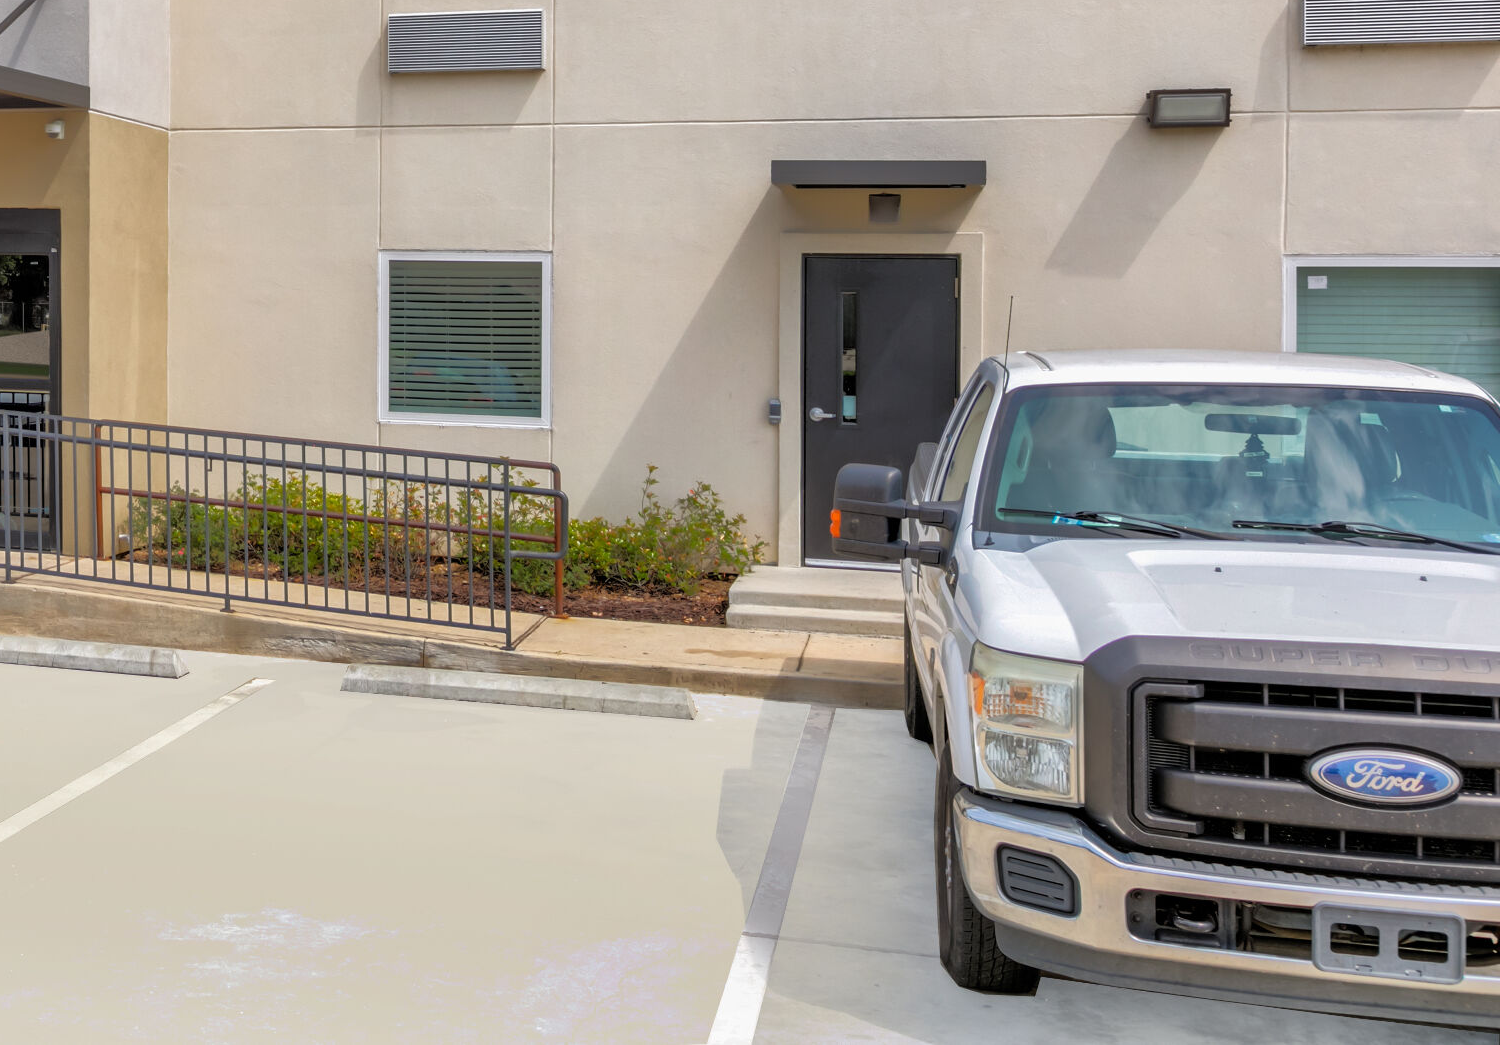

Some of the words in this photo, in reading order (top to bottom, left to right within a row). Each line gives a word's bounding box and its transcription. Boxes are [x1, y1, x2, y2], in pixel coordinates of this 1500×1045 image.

[1188, 640, 1384, 669] SUPER
[1412, 653, 1500, 675] DU
[1346, 759, 1427, 793] Ford
